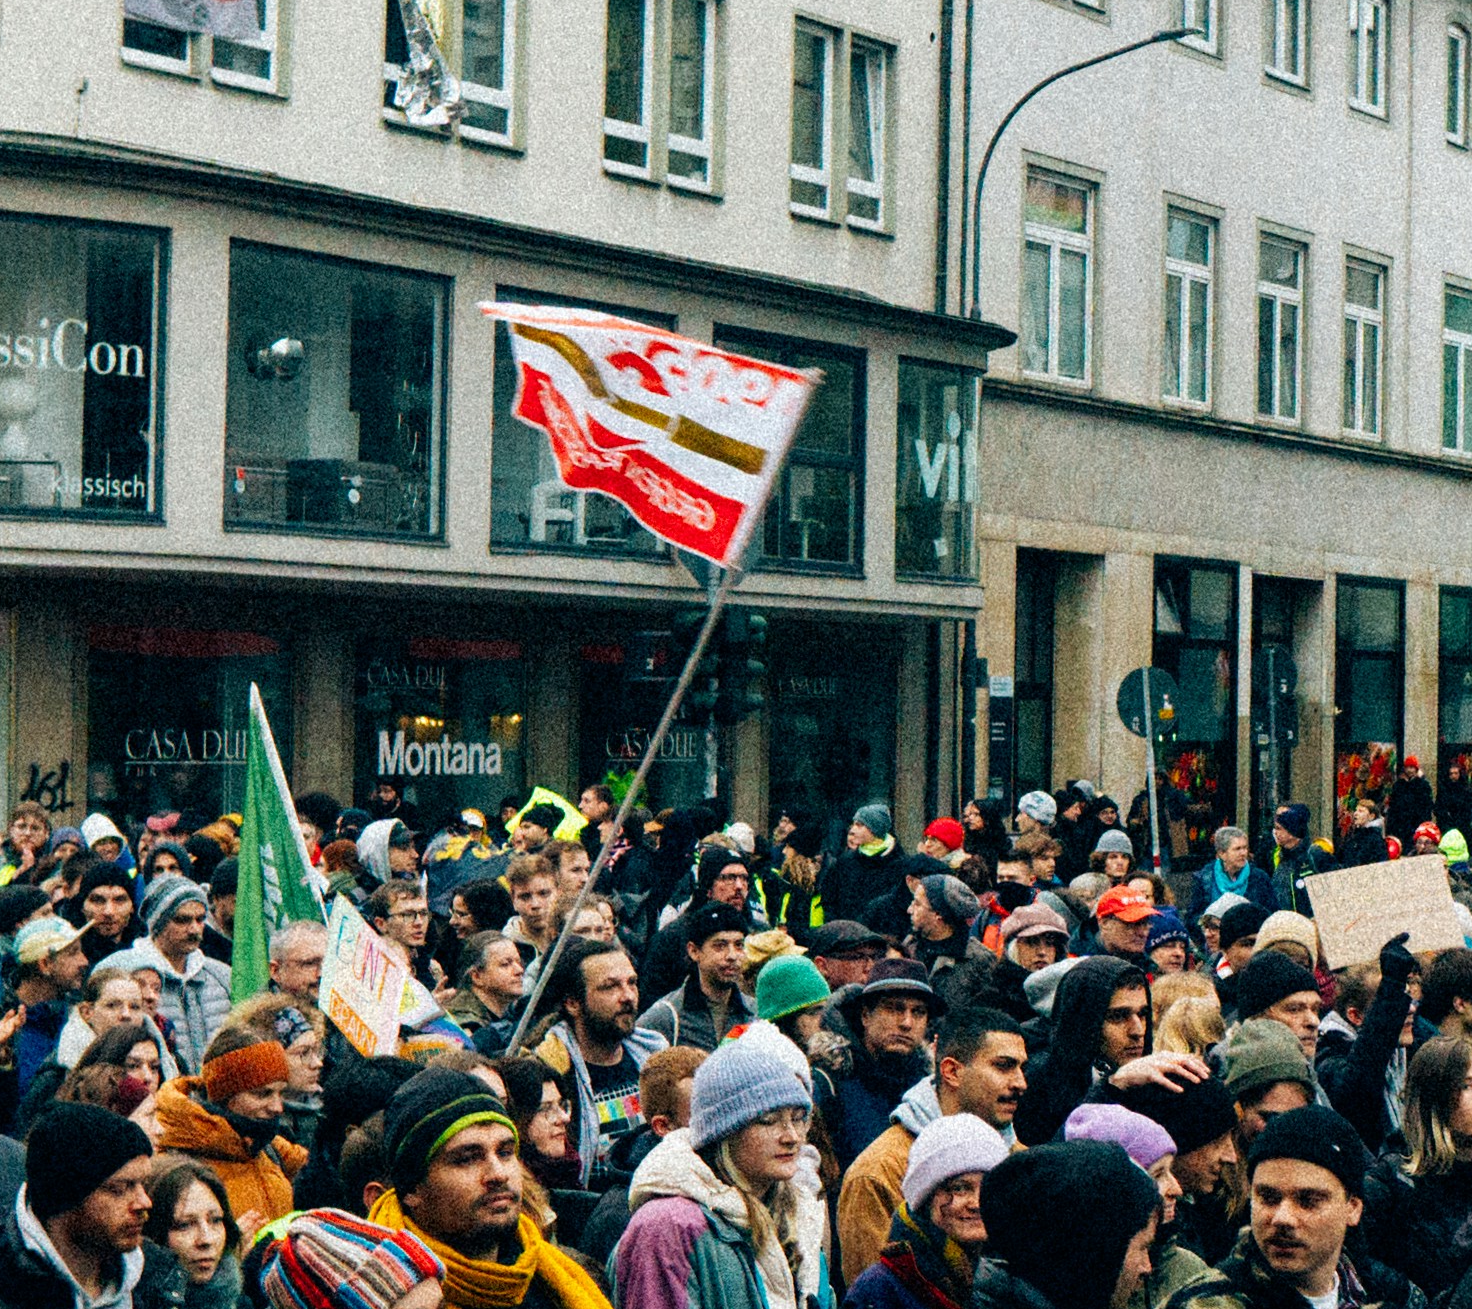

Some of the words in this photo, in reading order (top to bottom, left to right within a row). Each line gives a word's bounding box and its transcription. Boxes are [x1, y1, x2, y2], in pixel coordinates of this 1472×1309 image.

[125, 728, 192, 759] CASA
[377, 729, 502, 777] Montana
[21, 760, 74, 812] 161
